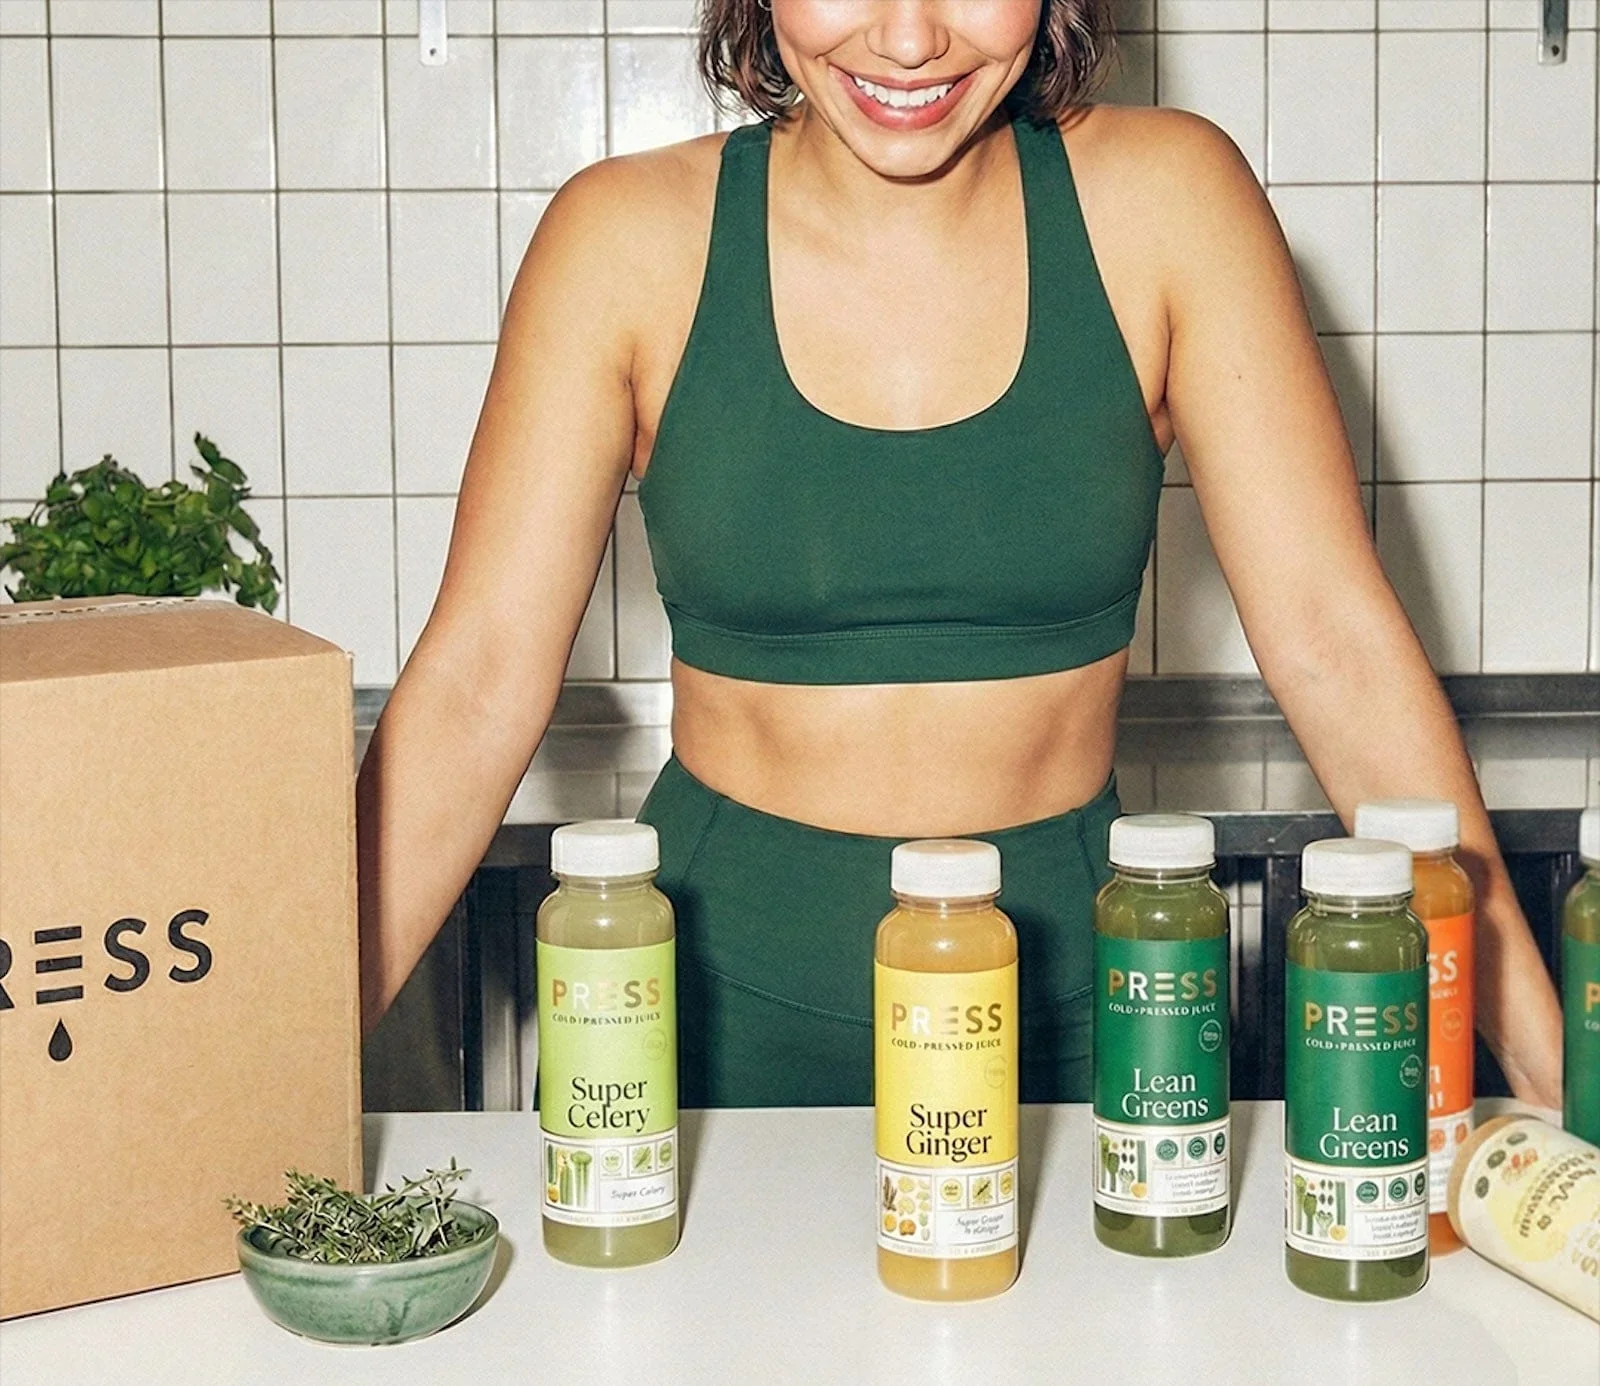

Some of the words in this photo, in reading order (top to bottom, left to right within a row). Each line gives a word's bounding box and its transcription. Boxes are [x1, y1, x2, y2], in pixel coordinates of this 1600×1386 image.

[551, 977, 661, 1010] PRESS
[1108, 968, 1217, 1002] PRESS
[891, 1002, 1002, 1035] PRESS
[1304, 1001, 1419, 1037] PRESS
[571, 1076, 648, 1108] Super
[1134, 1067, 1197, 1094] Lean
[567, 1103, 650, 1134] Celery
[910, 1103, 988, 1136] Super
[1121, 1092, 1210, 1119] Greens
[1332, 1106, 1398, 1134] Lean
[906, 1129, 993, 1164] Ginger
[1319, 1132, 1410, 1160] Greens
